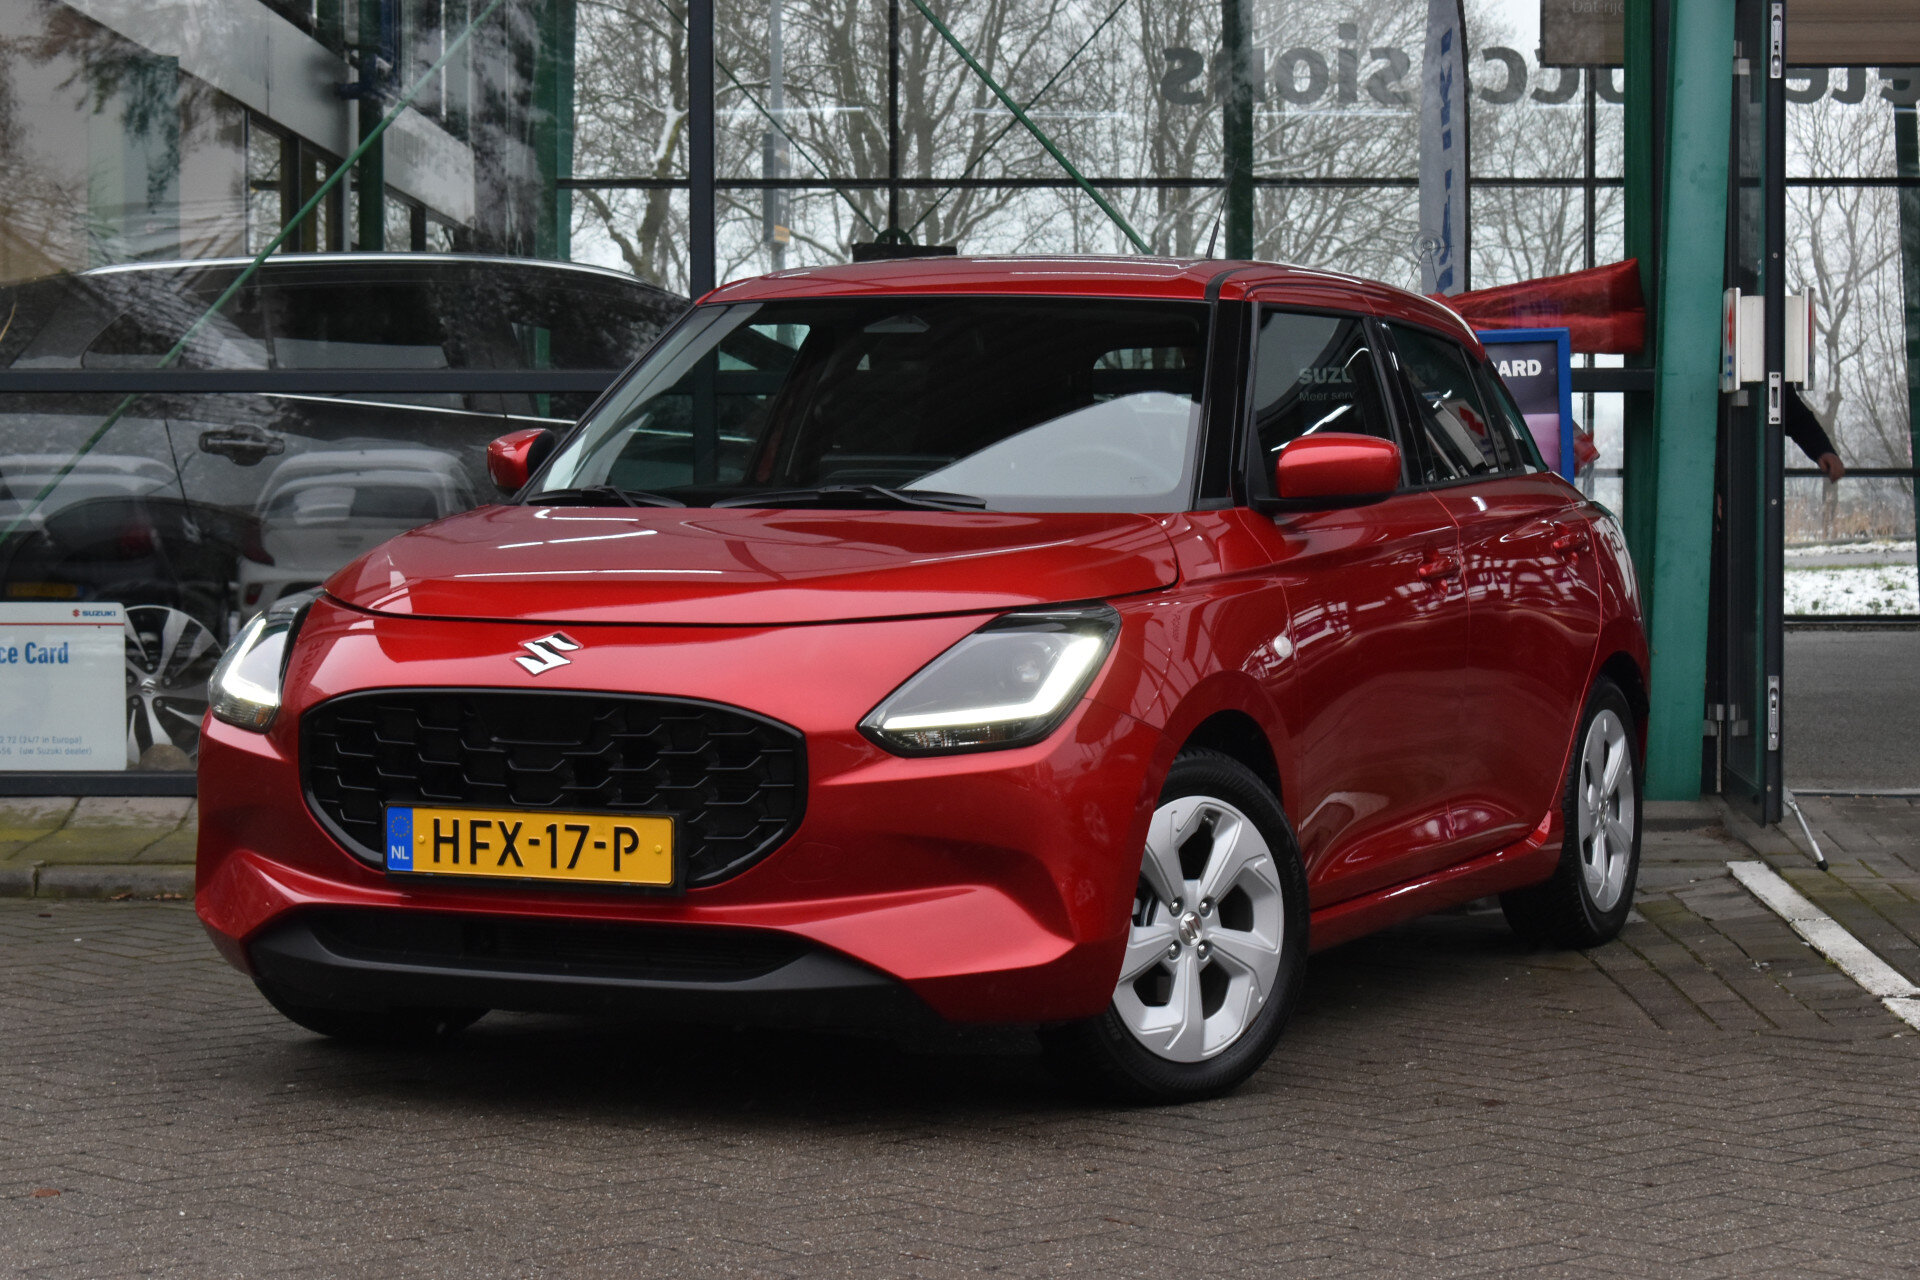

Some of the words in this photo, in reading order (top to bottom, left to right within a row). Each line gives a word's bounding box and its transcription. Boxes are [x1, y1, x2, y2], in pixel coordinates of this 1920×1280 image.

[1492, 360, 1542, 377] ARD
[25, 641, 69, 664] Card
[42, 736, 50, 744] in
[37, 747, 62, 755] Suzuki
[391, 845, 410, 860] NL
[432, 818, 640, 872] HFX-17-P
